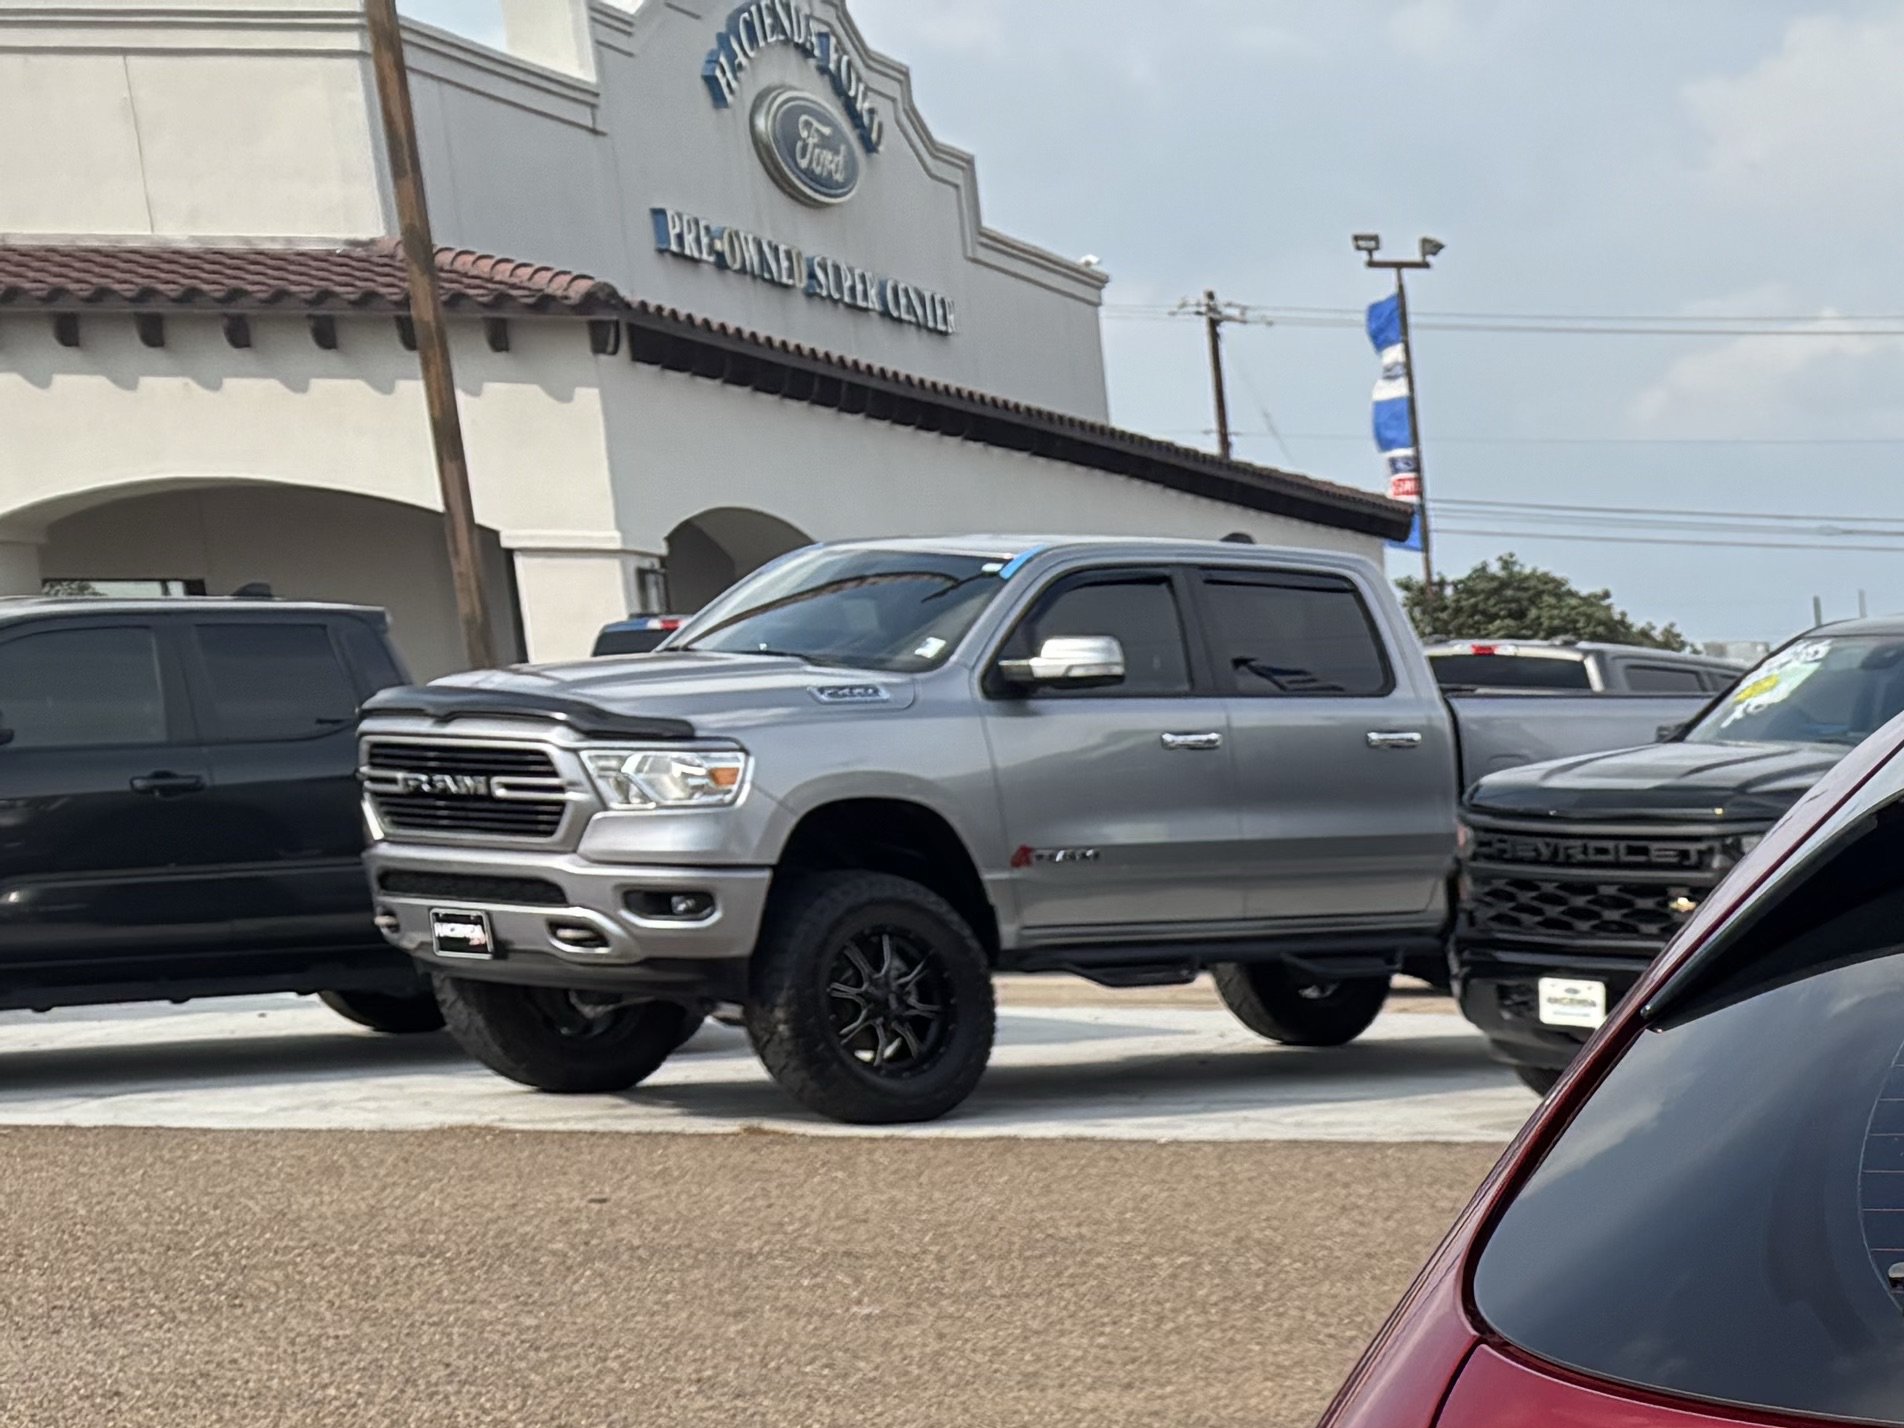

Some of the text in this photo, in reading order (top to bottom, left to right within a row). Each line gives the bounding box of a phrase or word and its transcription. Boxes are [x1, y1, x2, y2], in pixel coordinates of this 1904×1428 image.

[795, 113, 848, 183] Ford
[662, 208, 955, 334] PRE-OWNED SUPER CENTER
